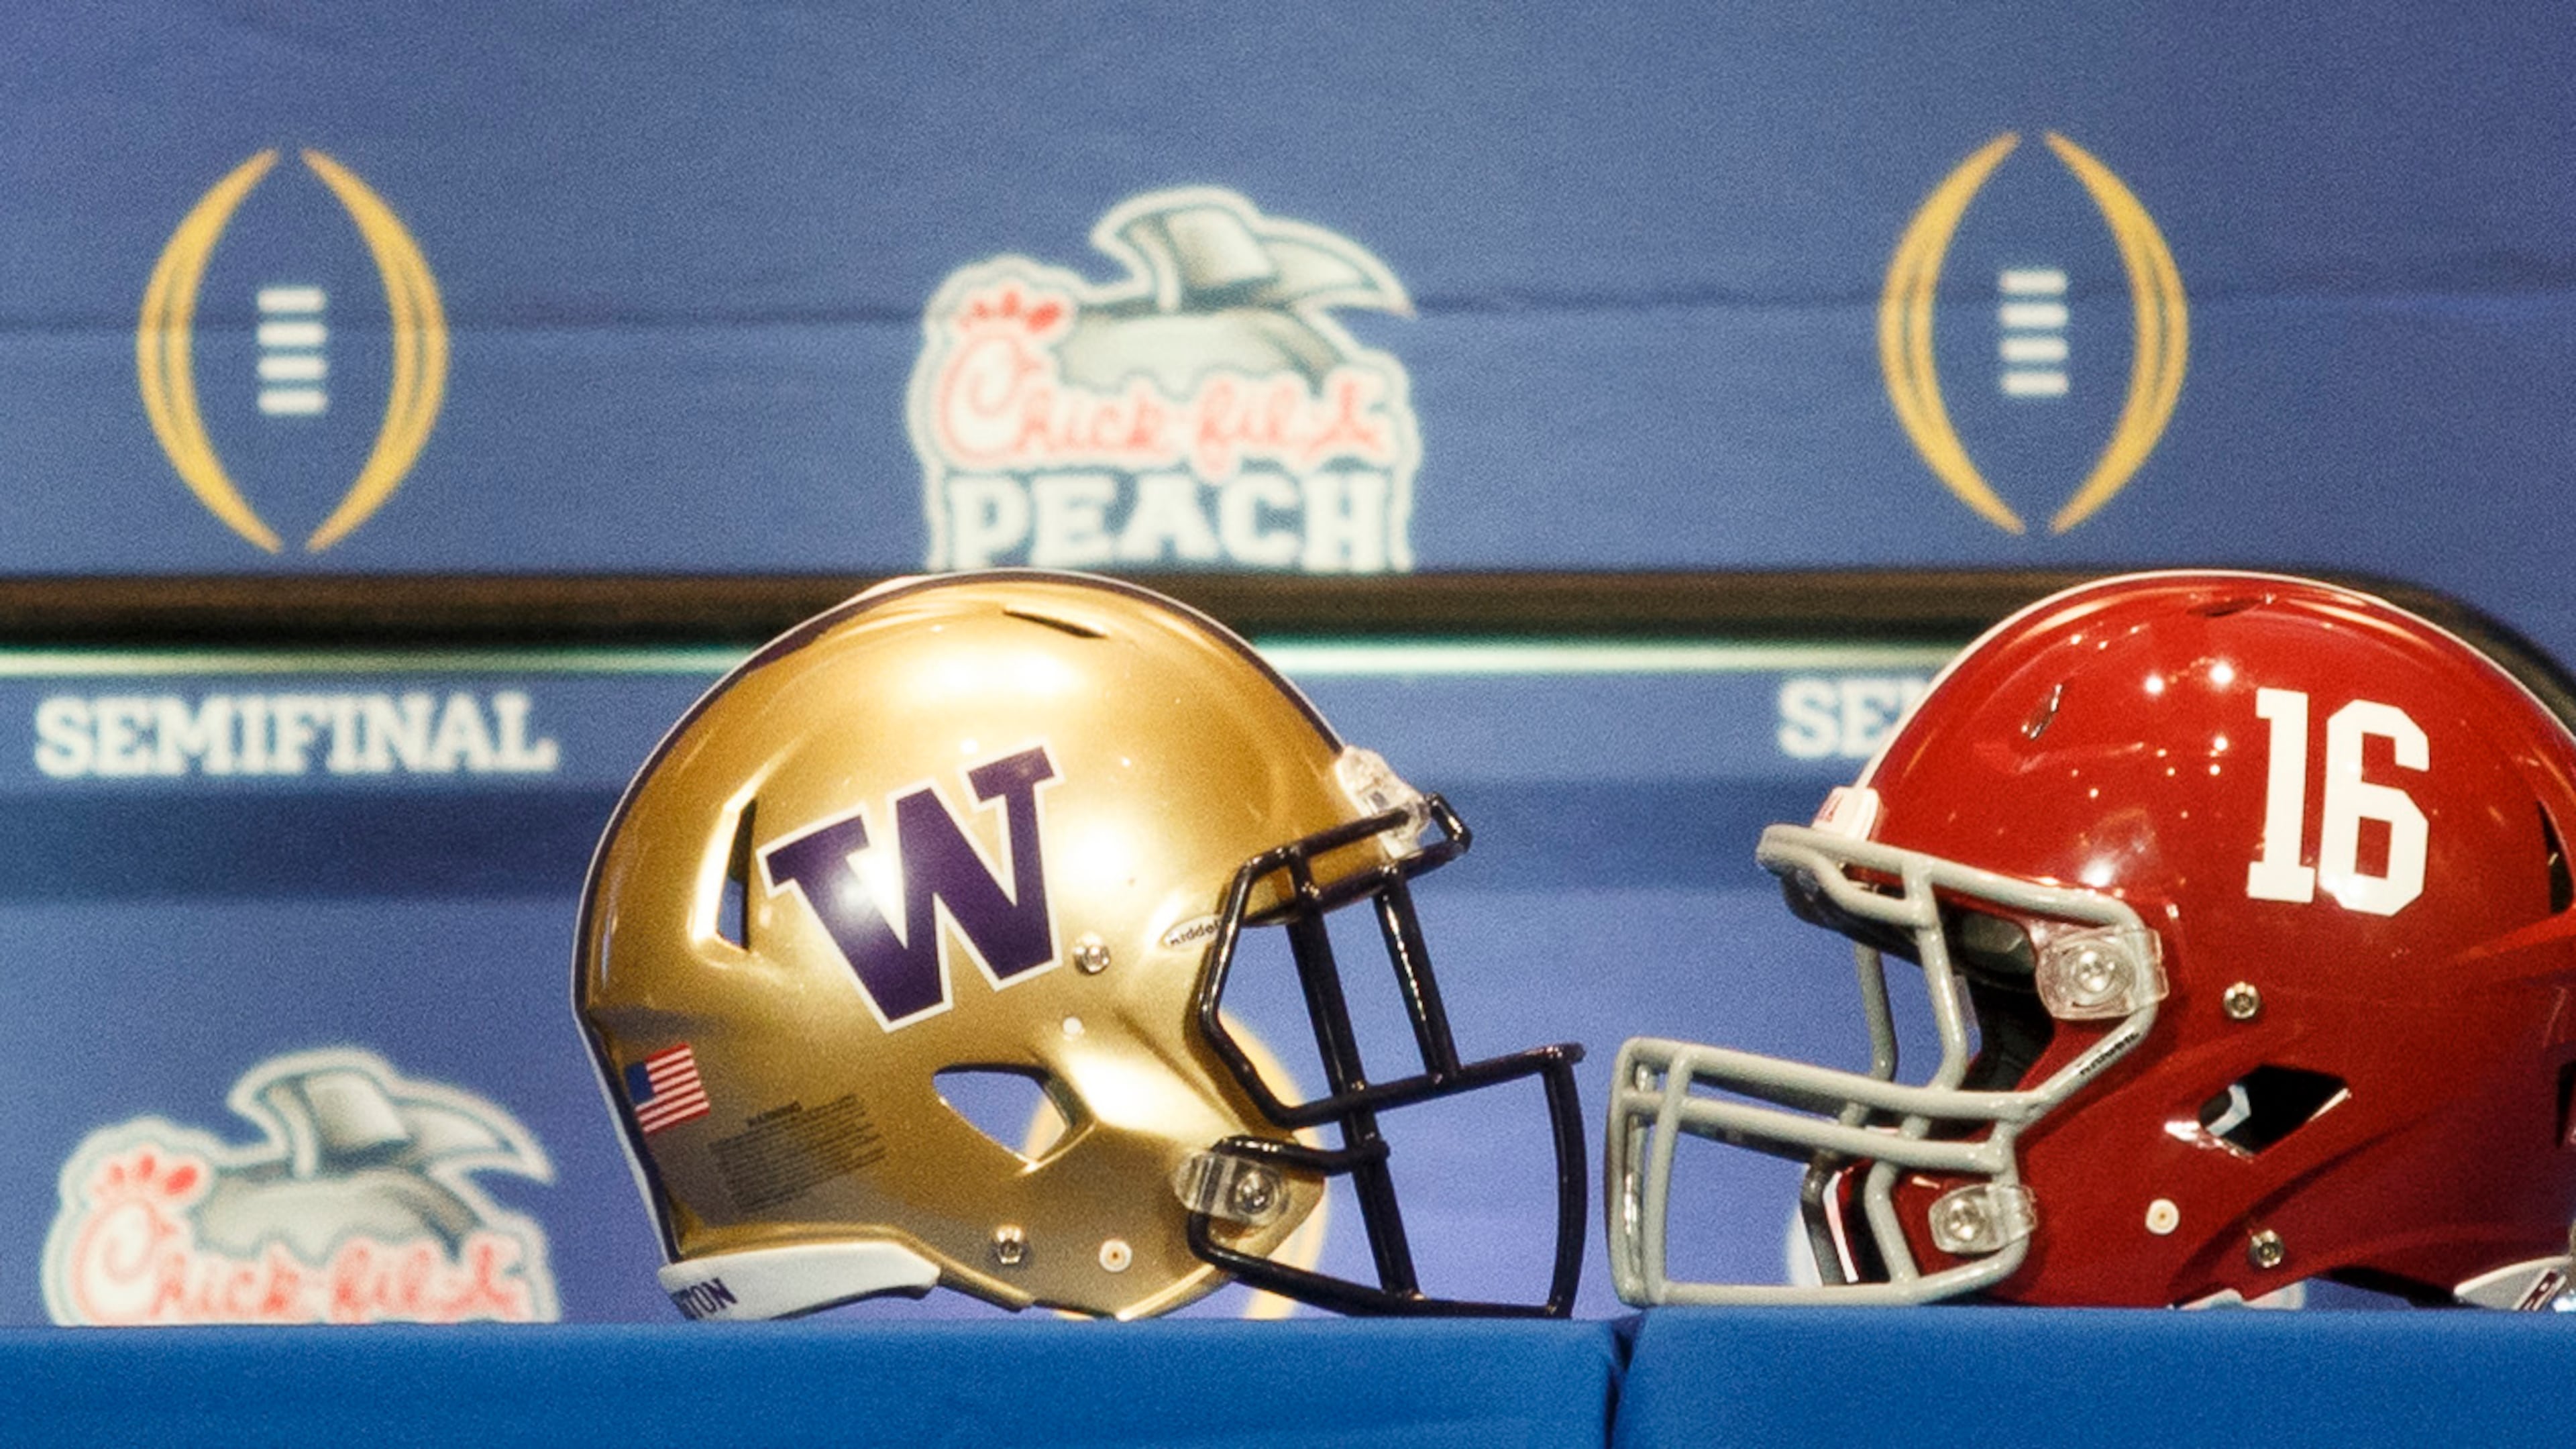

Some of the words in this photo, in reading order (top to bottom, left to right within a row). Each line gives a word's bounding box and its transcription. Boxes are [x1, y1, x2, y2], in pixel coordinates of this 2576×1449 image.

[947, 471, 1389, 572] PEACH
[35, 692, 561, 777] SEMIFINAL
[1778, 678, 1929, 758] SE
[2247, 686, 2430, 917] 16
[757, 739, 1065, 1032] W
[672, 1277, 738, 1320] TON
